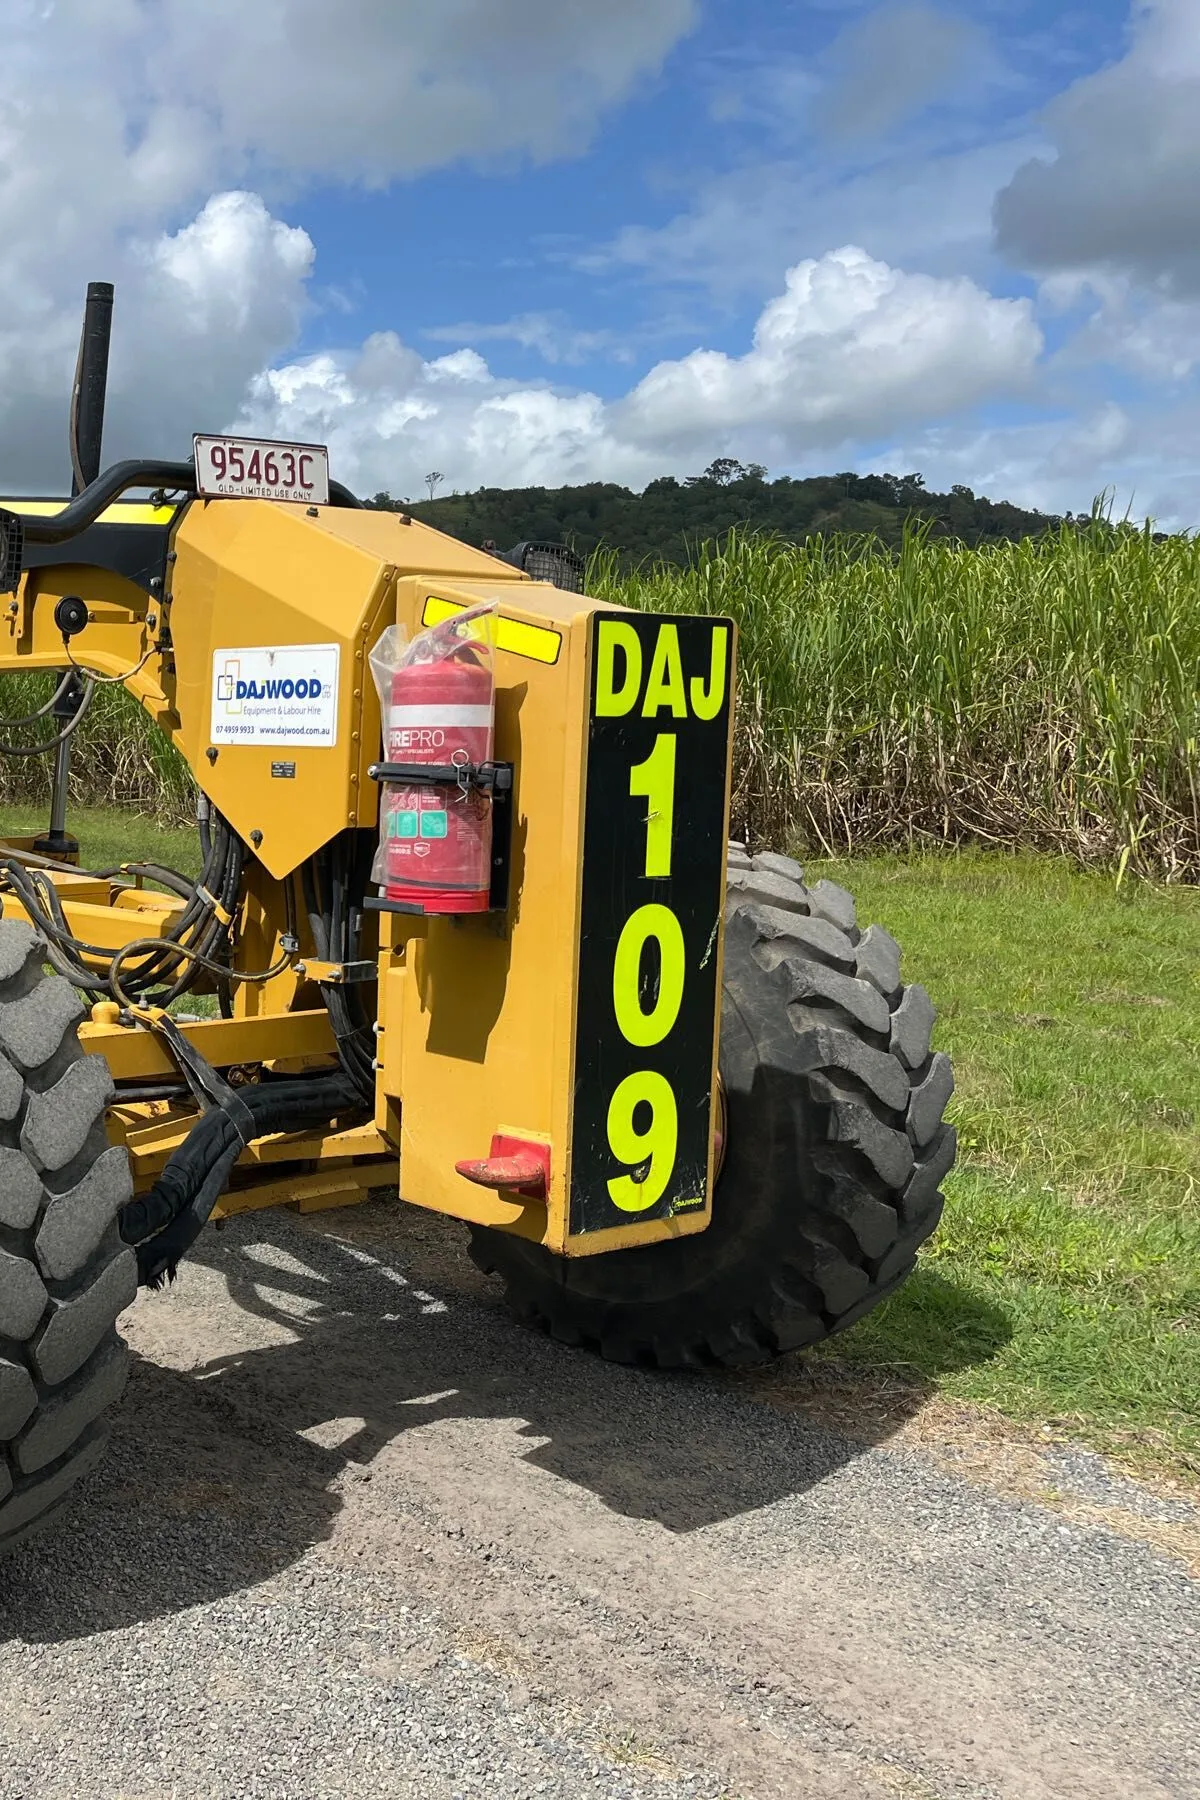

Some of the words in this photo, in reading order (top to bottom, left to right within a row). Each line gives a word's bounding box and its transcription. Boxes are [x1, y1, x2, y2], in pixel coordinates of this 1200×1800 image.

[210, 445, 315, 489] 95463C
[274, 488, 290, 498] USE
[292, 490, 312, 500] ONLY
[595, 621, 728, 720] DAJ
[235, 678, 322, 700] DAJWOOD
[243, 705, 277, 717] Equipment
[277, 705, 283, 715] &
[283, 705, 307, 715] Labour
[307, 704, 321, 715] Hire
[215, 725, 223, 734] 07
[223, 725, 239, 734] 4959
[239, 725, 255, 734] 9933
[259, 725, 330, 737] www.dajwood.com.au
